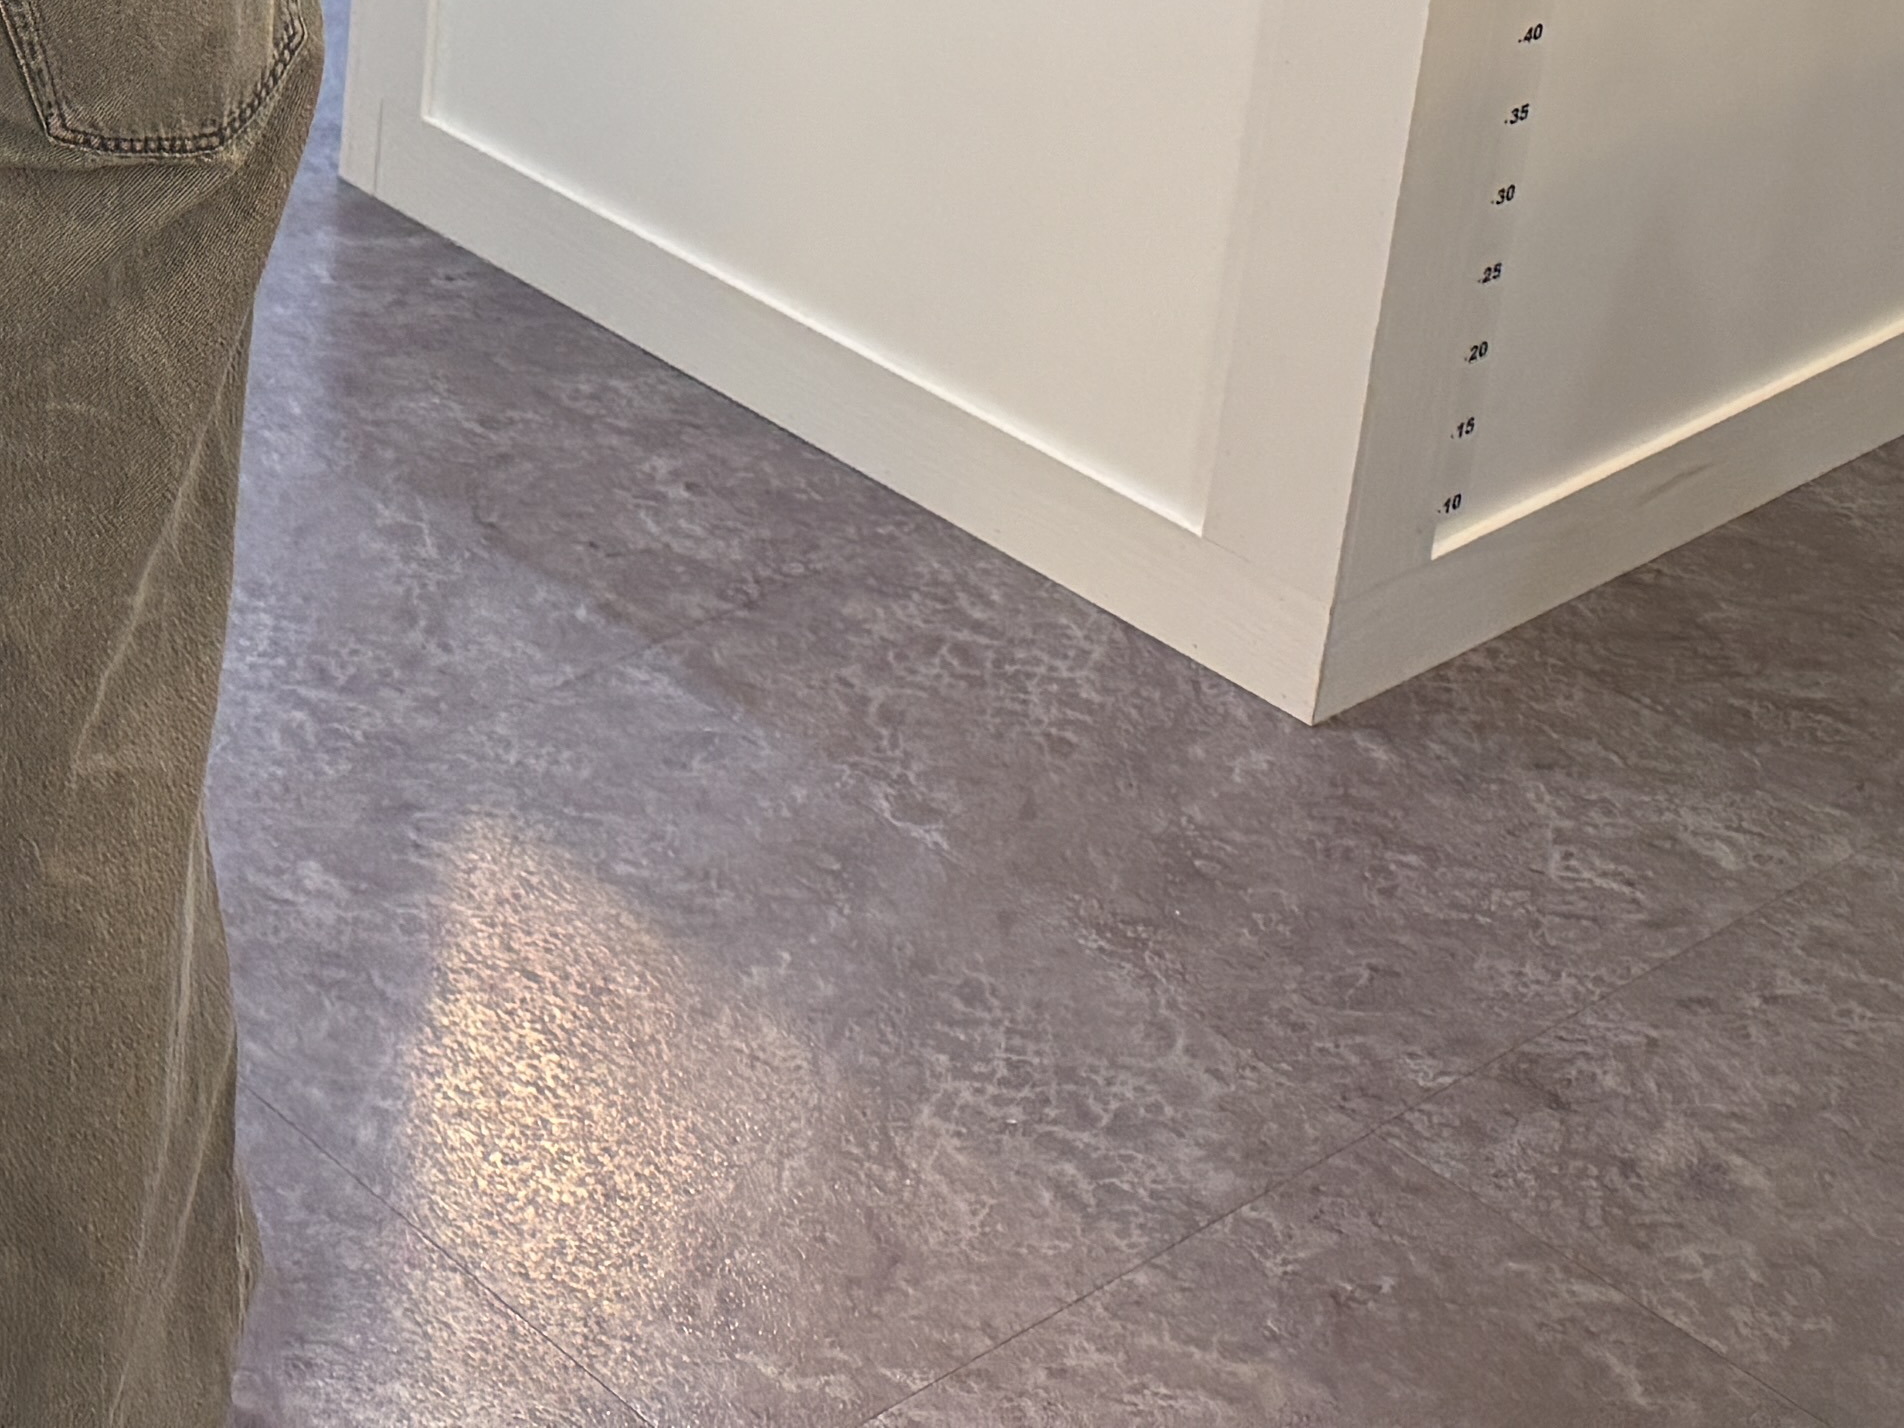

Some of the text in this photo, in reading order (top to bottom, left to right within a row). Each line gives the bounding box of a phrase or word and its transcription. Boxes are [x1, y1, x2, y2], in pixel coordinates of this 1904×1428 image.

[1523, 22, 1544, 44] 40
[1509, 102, 1530, 125] 35
[1496, 183, 1516, 206] 30
[1483, 262, 1503, 284] 25
[1470, 340, 1489, 364] 20
[1456, 416, 1475, 439] 15
[1443, 493, 1462, 514] 10
